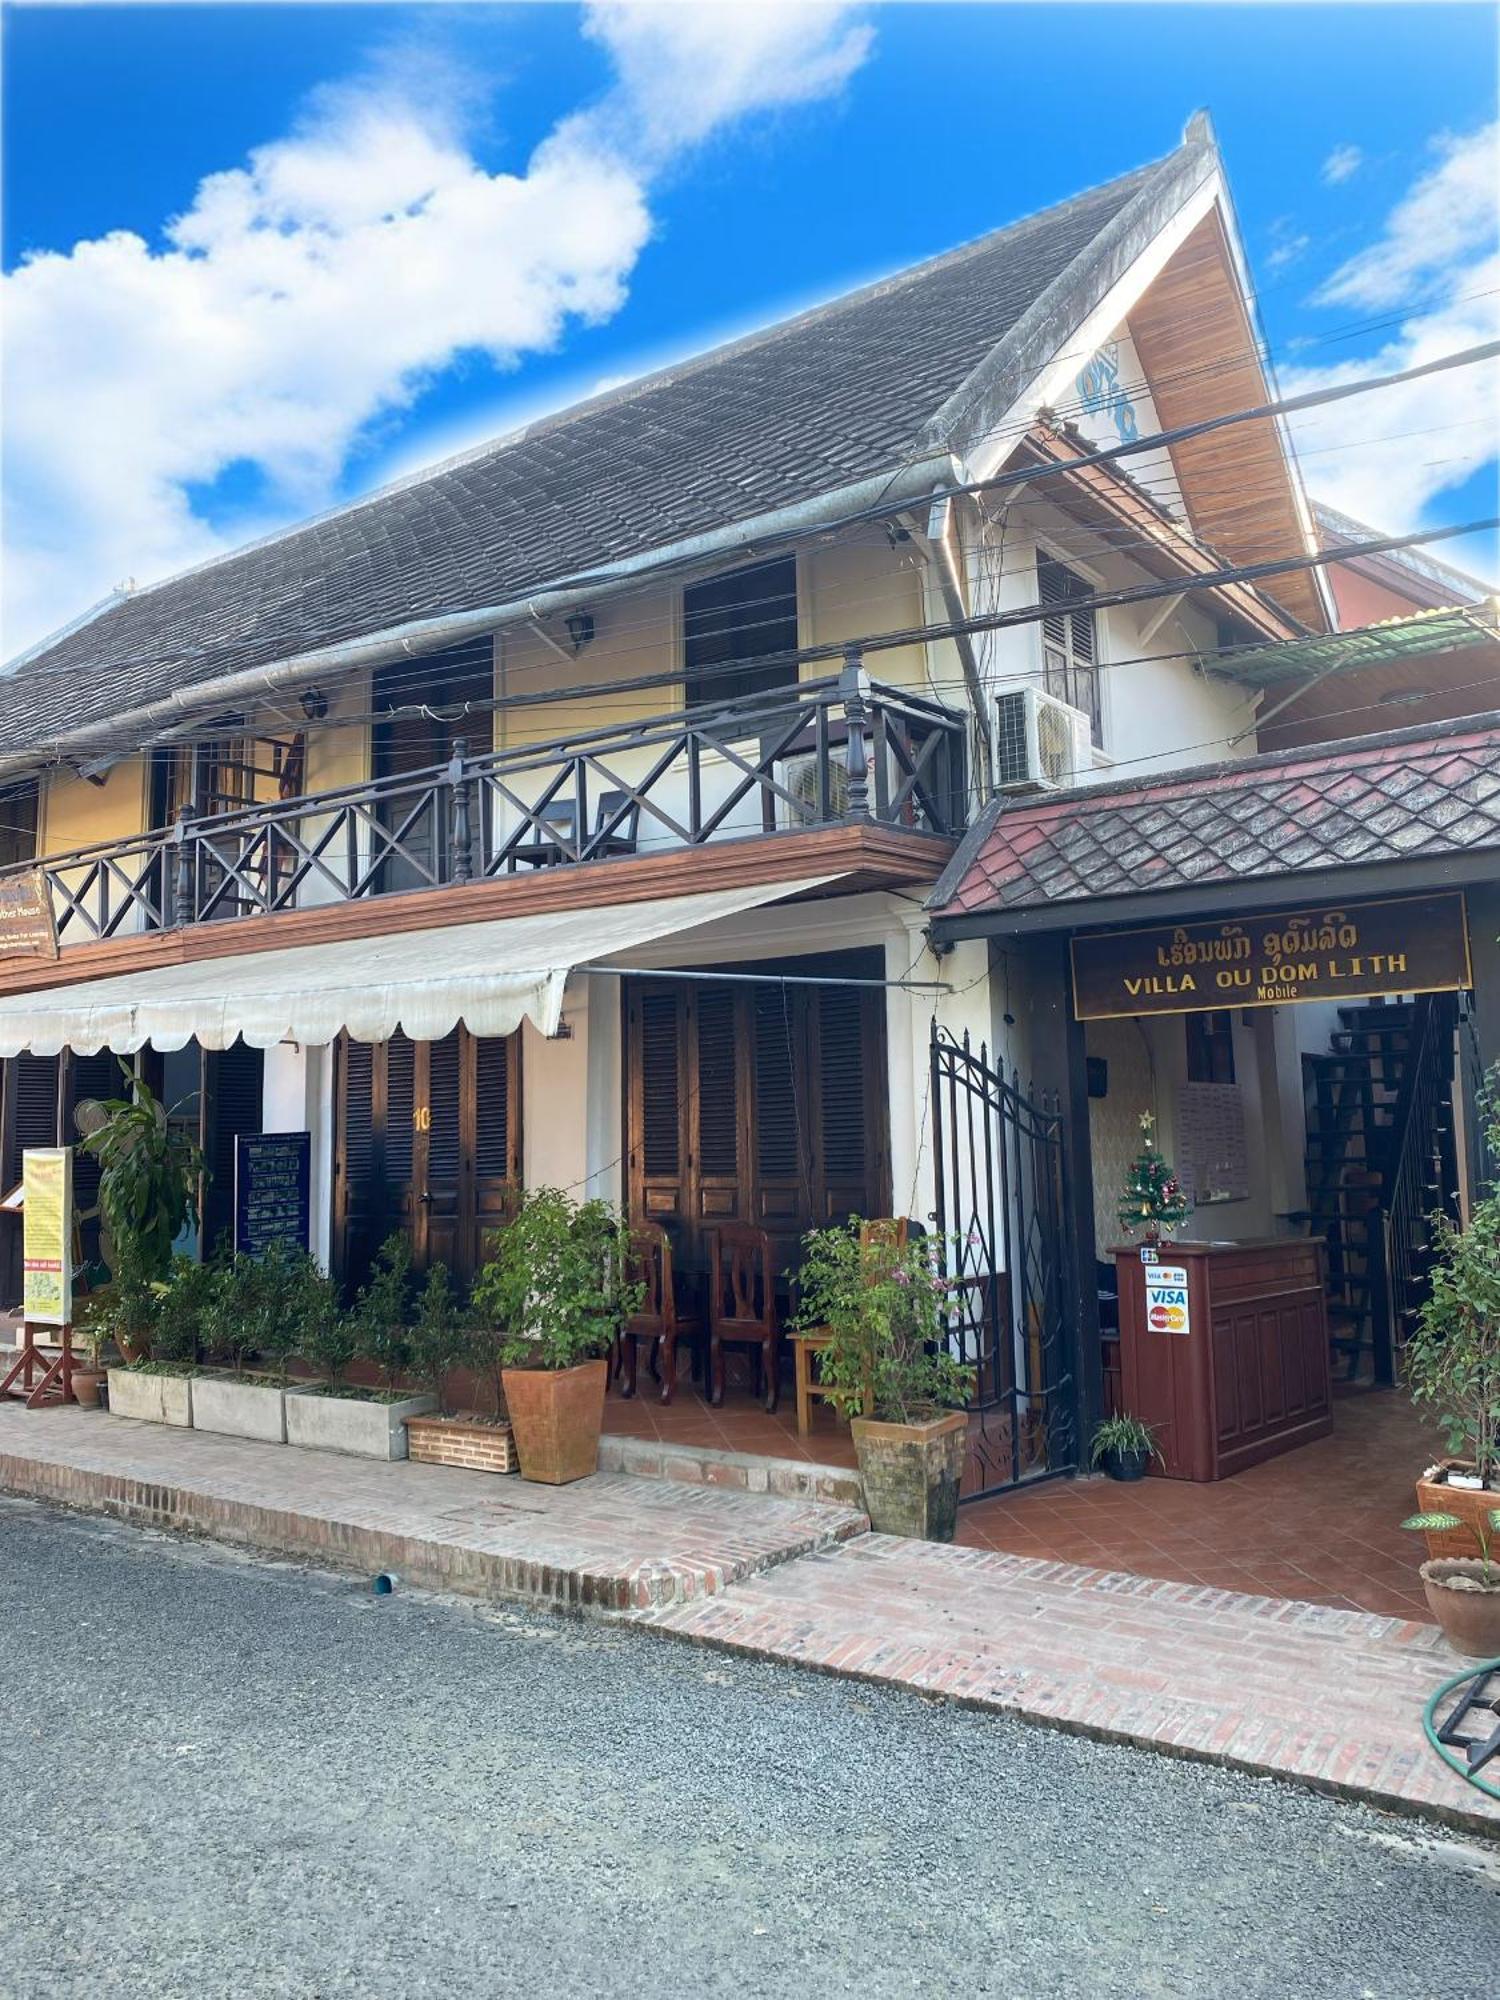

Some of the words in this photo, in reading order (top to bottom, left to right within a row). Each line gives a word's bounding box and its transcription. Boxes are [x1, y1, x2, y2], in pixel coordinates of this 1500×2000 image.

[1123, 974, 1196, 996] VILLA
[1215, 968, 1251, 988] OU
[1261, 963, 1318, 985] DOM
[1329, 954, 1407, 977] LITH
[1257, 984, 1298, 1000] Mobile
[412, 1107, 431, 1131] 10
[1151, 1290, 1185, 1305] VISA
